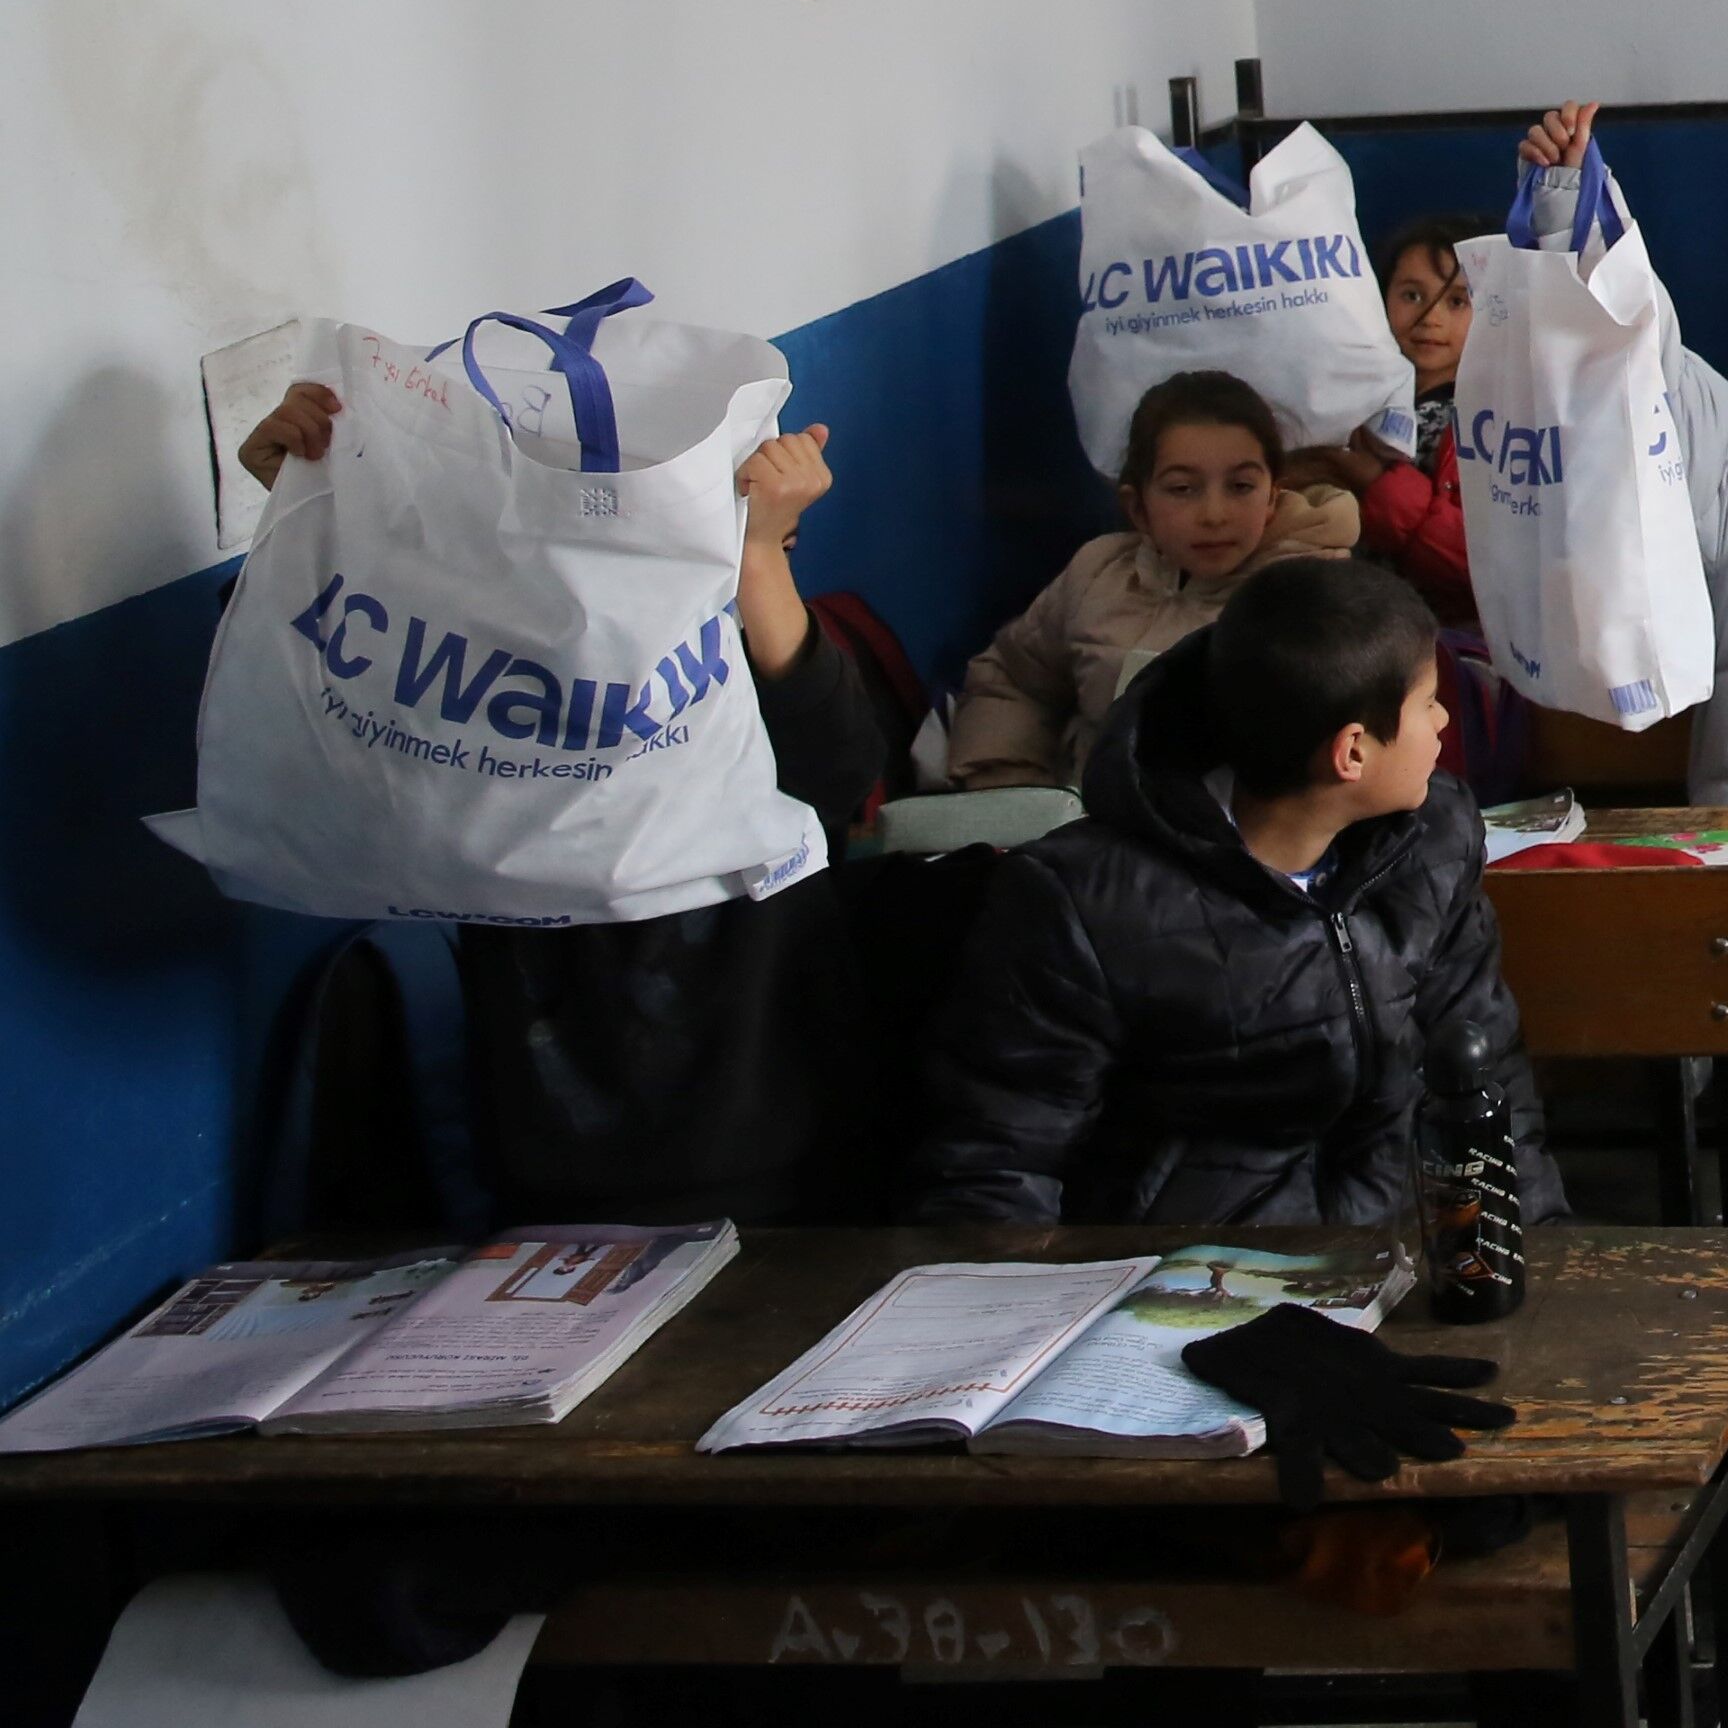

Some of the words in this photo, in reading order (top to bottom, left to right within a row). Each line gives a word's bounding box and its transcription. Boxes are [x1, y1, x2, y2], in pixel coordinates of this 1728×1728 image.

[1127, 306, 1201, 335] giyinmek
[1203, 294, 1278, 321] herkesin
[477, 738, 614, 783] herkesin
[1471, 1177, 1506, 1197] RACING
